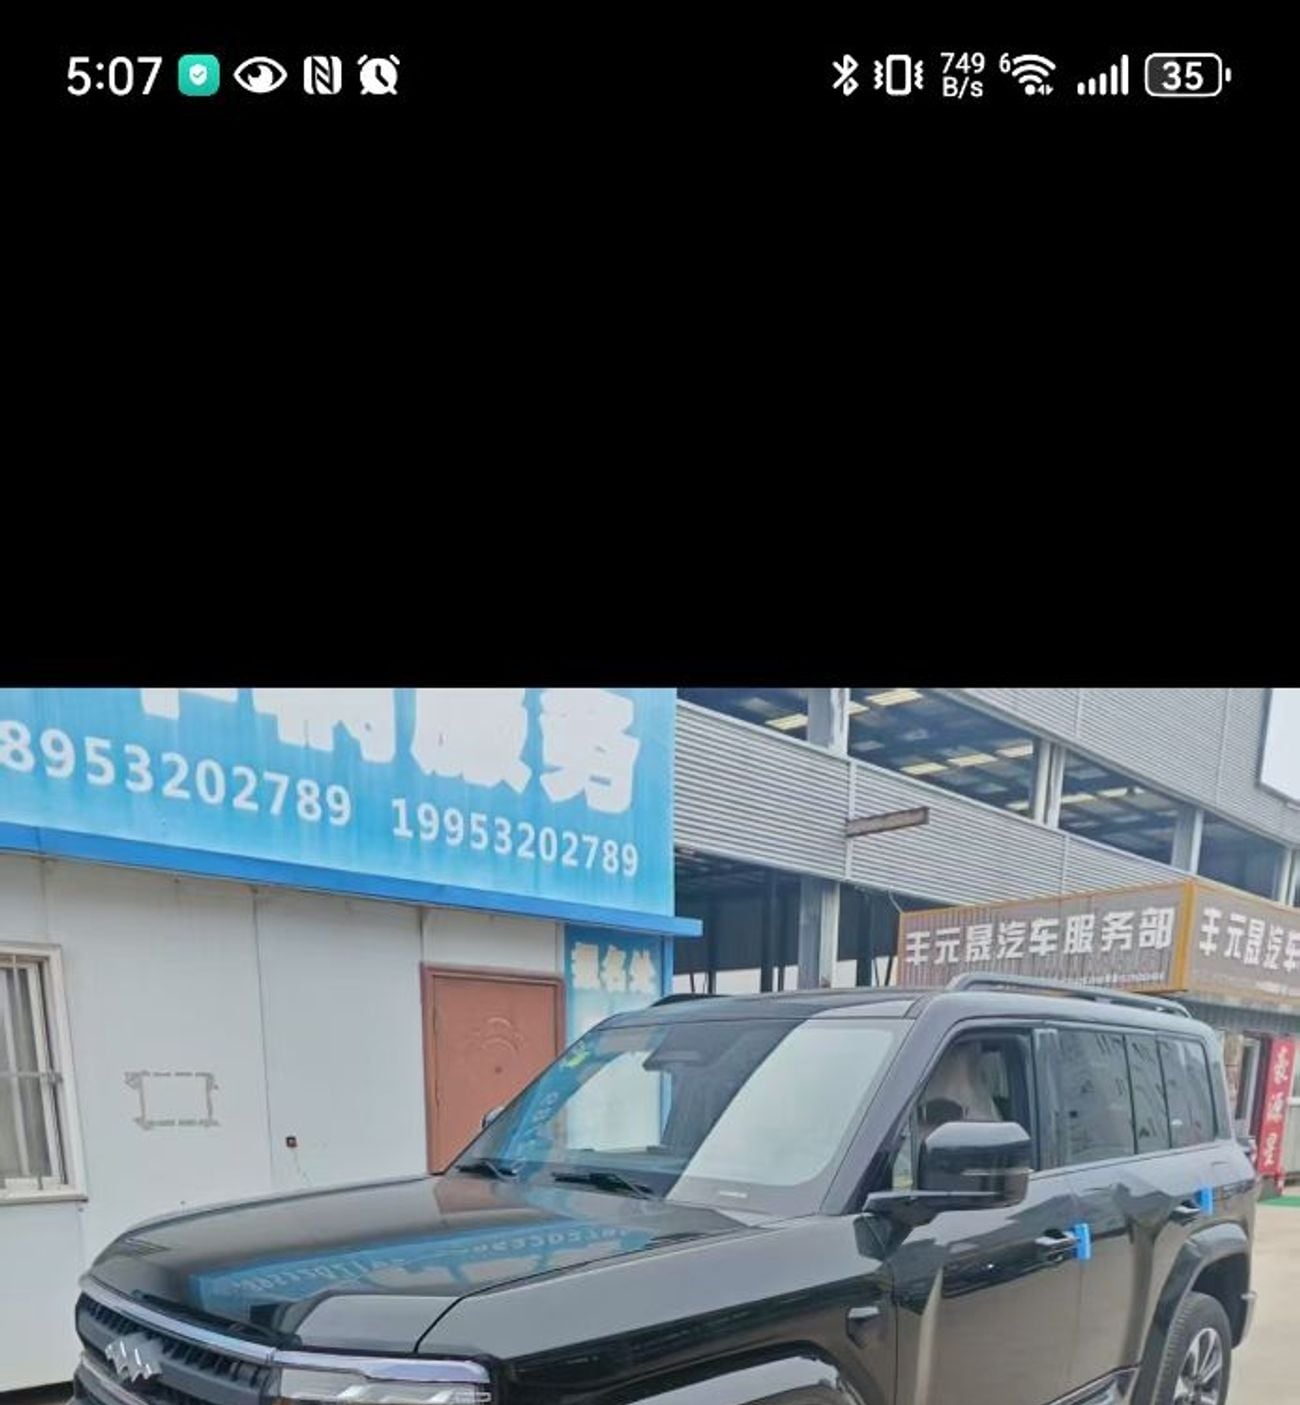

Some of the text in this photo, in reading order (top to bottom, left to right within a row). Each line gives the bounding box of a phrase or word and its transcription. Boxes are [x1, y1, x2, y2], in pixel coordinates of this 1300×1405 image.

[0, 719, 639, 877] 8953202789 19953202789
[904, 907, 1175, 966] 丰元晟汽车服务部
